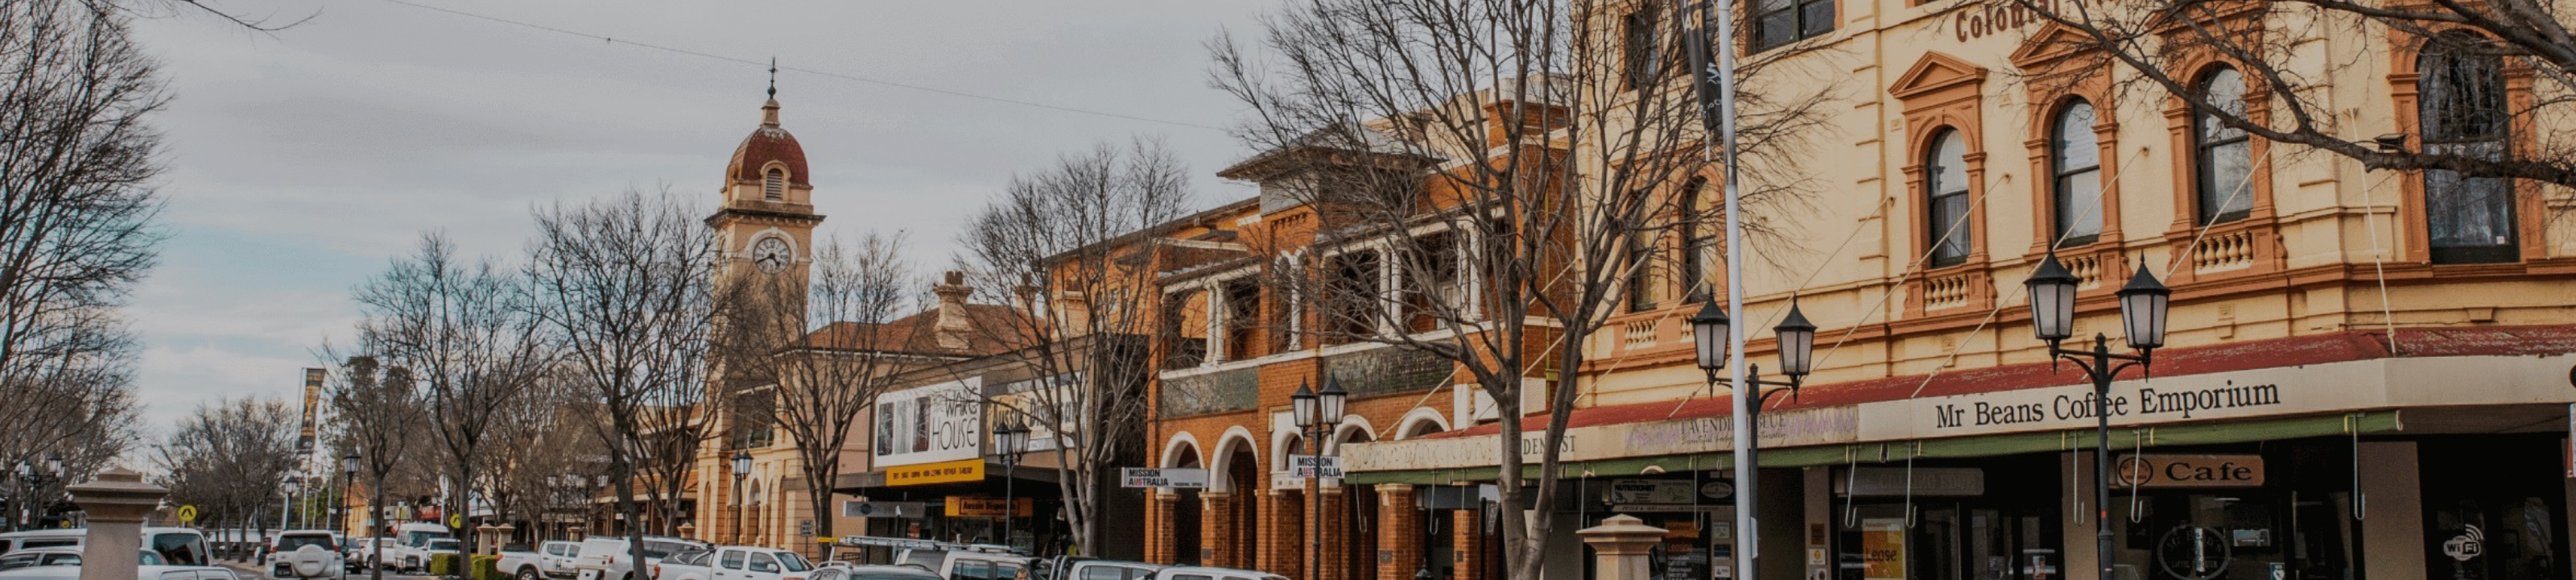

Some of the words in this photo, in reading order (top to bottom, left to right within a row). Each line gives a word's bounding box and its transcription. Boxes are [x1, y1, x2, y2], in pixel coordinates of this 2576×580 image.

[1936, 404, 1965, 429] Mr
[1975, 401, 2045, 426] Beans
[2139, 379, 2281, 419] Emporium
[931, 417, 977, 451] HOUSE
[1523, 435, 1576, 455] DENST
[1298, 457, 1333, 467] MISSON
[1129, 469, 1161, 477] MISSION
[2165, 462, 2252, 481] Cafe
[1129, 478, 1169, 486] AUSTRALIA
[1866, 549, 1897, 562] Lease
